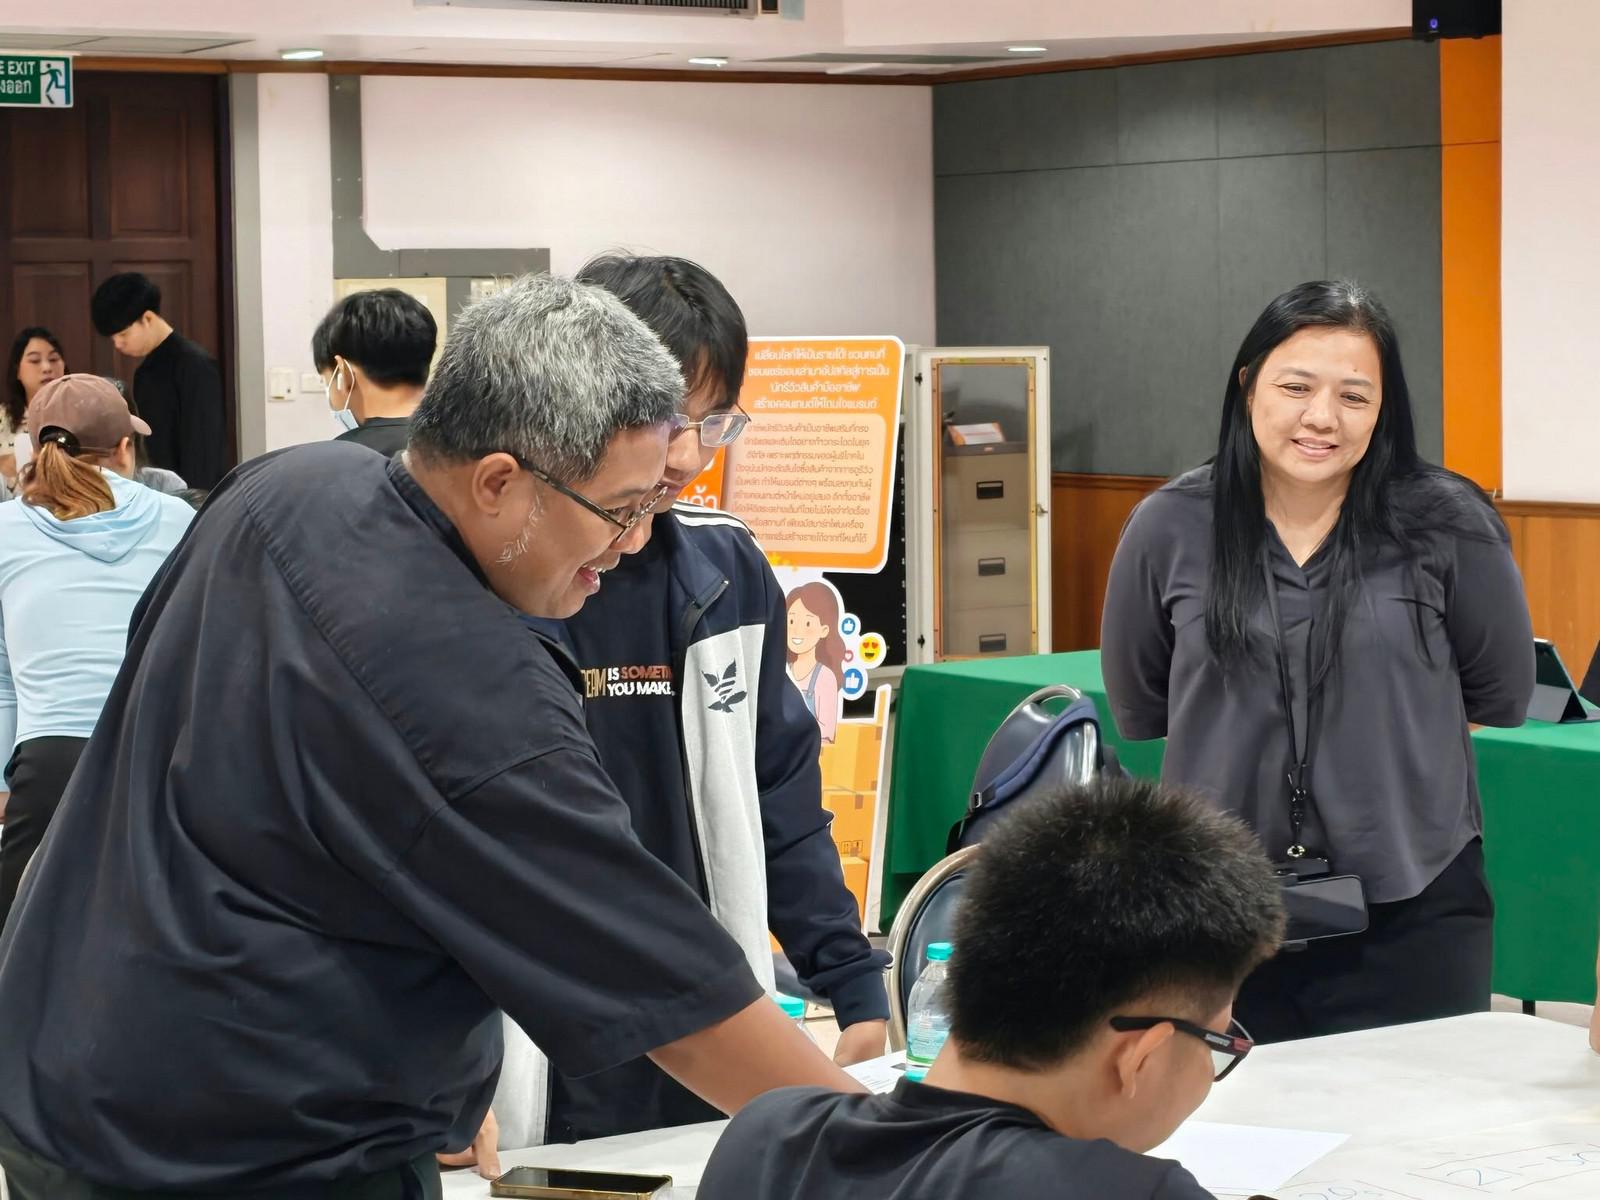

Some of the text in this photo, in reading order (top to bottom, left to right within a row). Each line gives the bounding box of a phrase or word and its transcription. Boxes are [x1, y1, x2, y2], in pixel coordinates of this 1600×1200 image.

[8, 61, 36, 75] EXIT
[607, 667, 620, 681] IS
[607, 682, 635, 696] YOU
